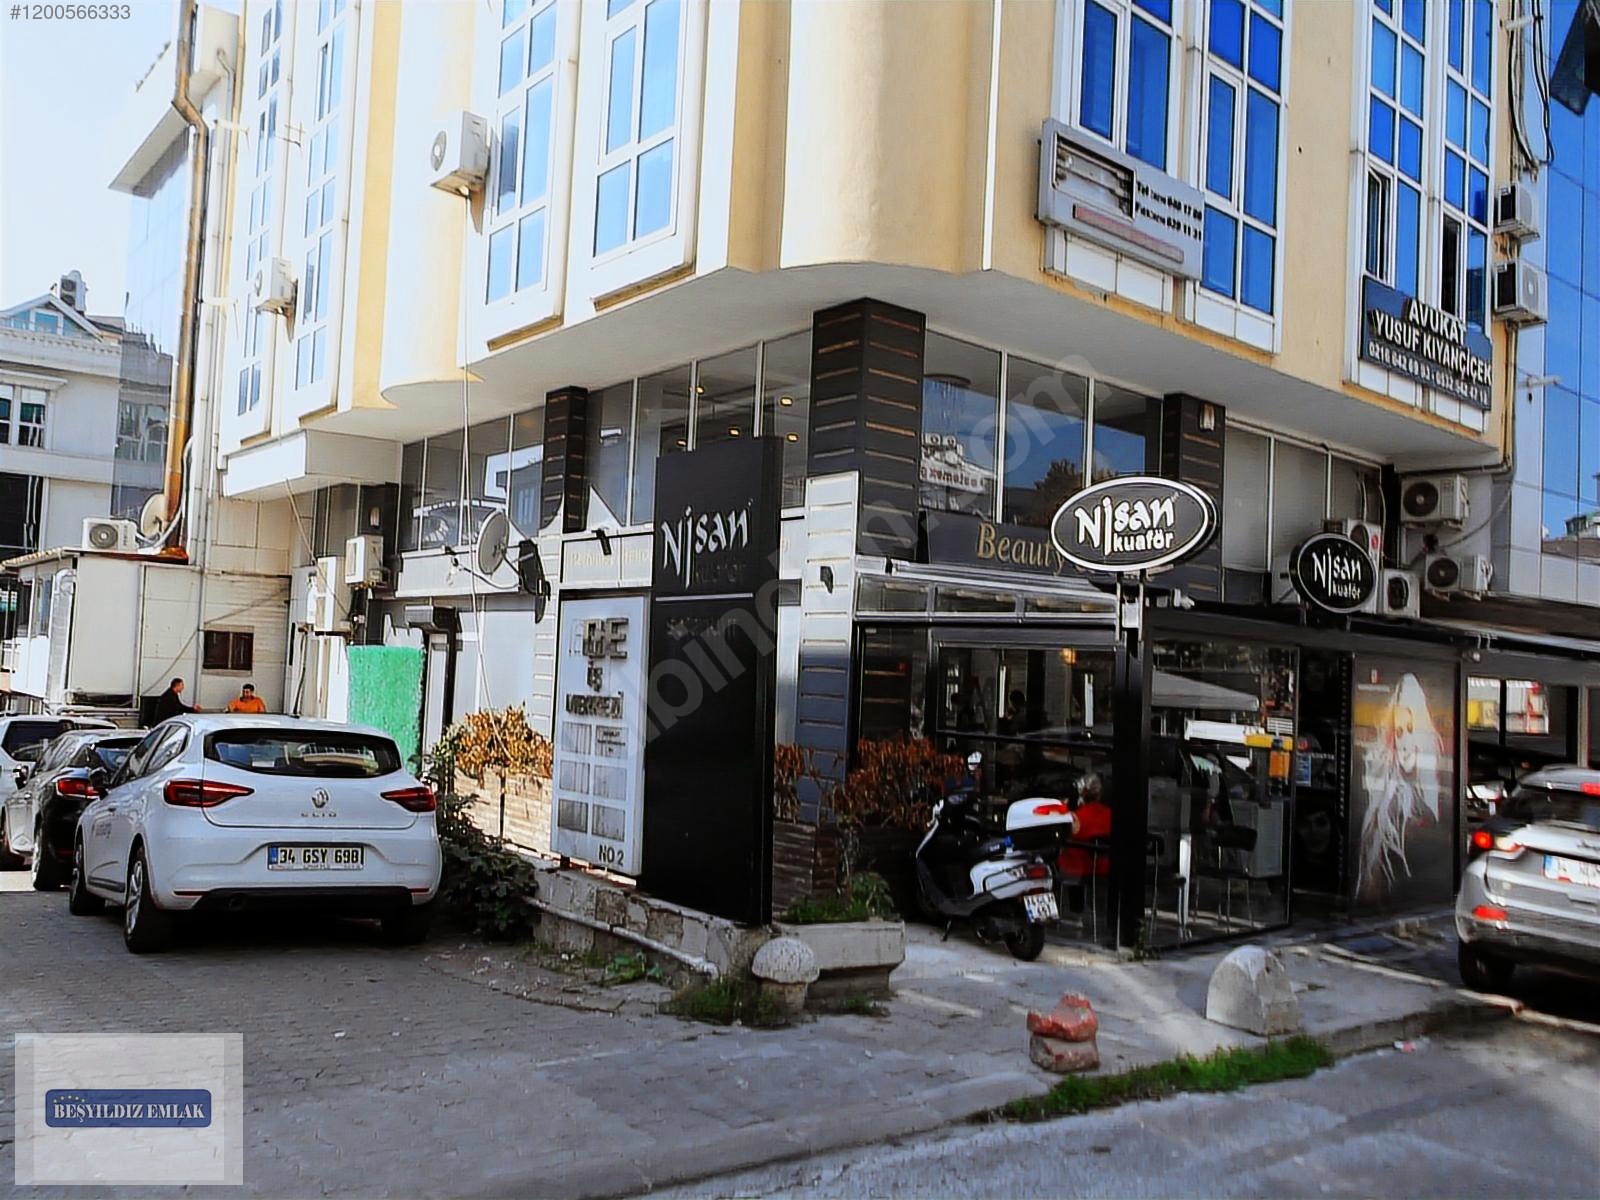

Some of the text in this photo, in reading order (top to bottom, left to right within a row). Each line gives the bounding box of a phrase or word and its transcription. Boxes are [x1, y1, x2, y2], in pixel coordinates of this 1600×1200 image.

[1374, 309, 1421, 352] YUSUF
[1408, 299, 1467, 346] AVUKAT
[660, 505, 750, 590] Nisan
[977, 521, 1066, 577] Beauty
[1073, 496, 1176, 556] Nisan
[1112, 529, 1176, 553] kuaför
[279, 849, 296, 864] 34
[302, 849, 328, 864] GSY
